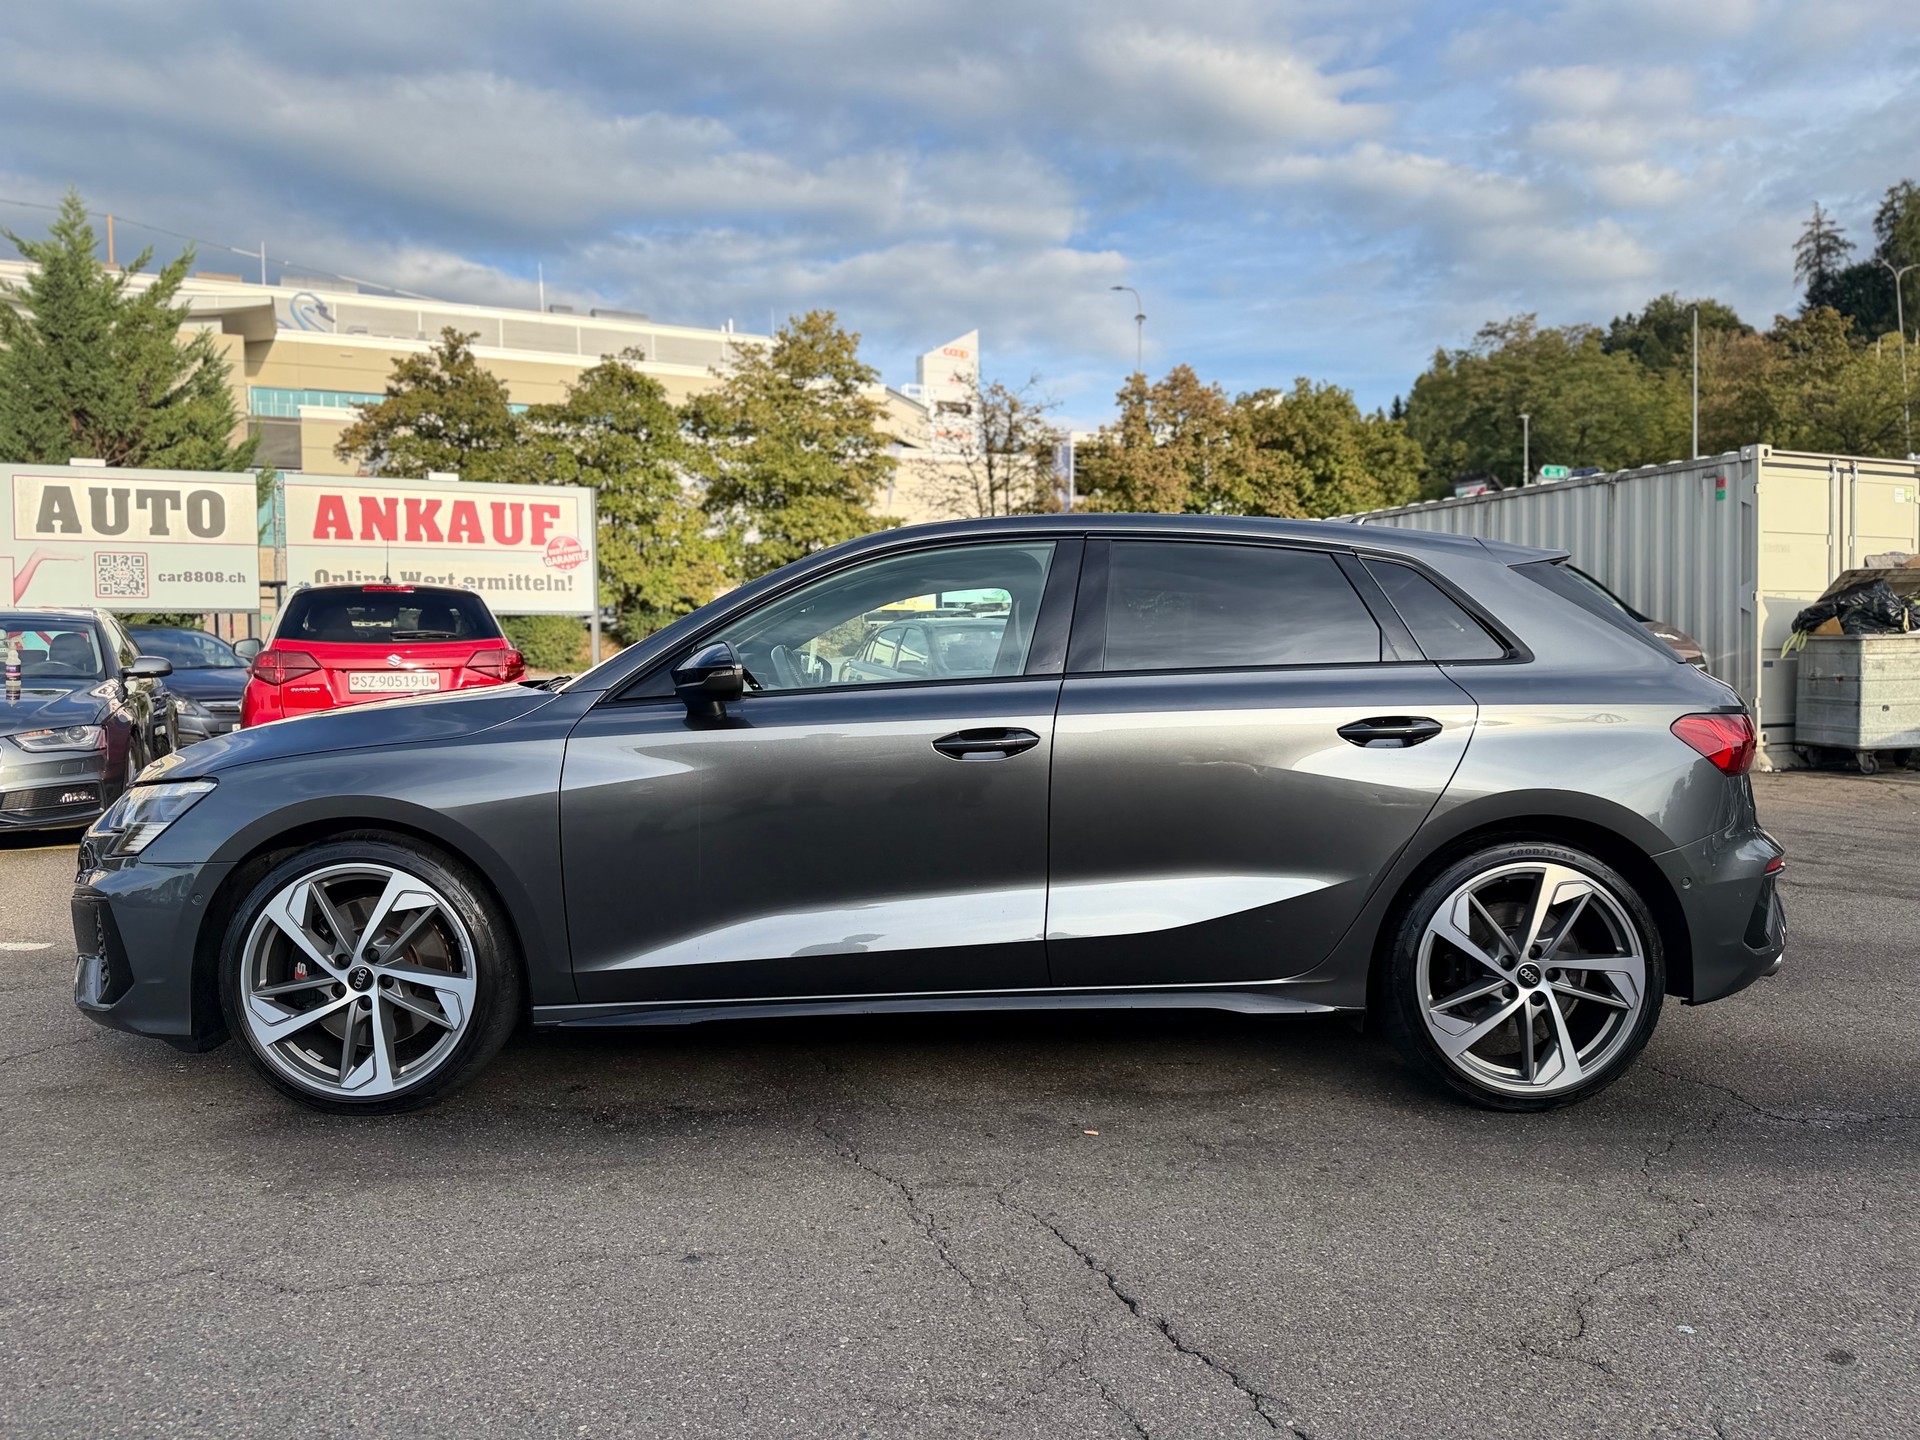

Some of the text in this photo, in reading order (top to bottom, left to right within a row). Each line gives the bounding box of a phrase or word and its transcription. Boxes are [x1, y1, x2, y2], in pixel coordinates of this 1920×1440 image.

[36, 485, 226, 538] AUTO
[313, 495, 560, 545] ANKAUF
[544, 551, 588, 566] GARANTIE
[158, 571, 246, 583] car8808.ch
[463, 573, 573, 592] ermitteln!
[1508, 848, 1577, 861] GOODYEAR
